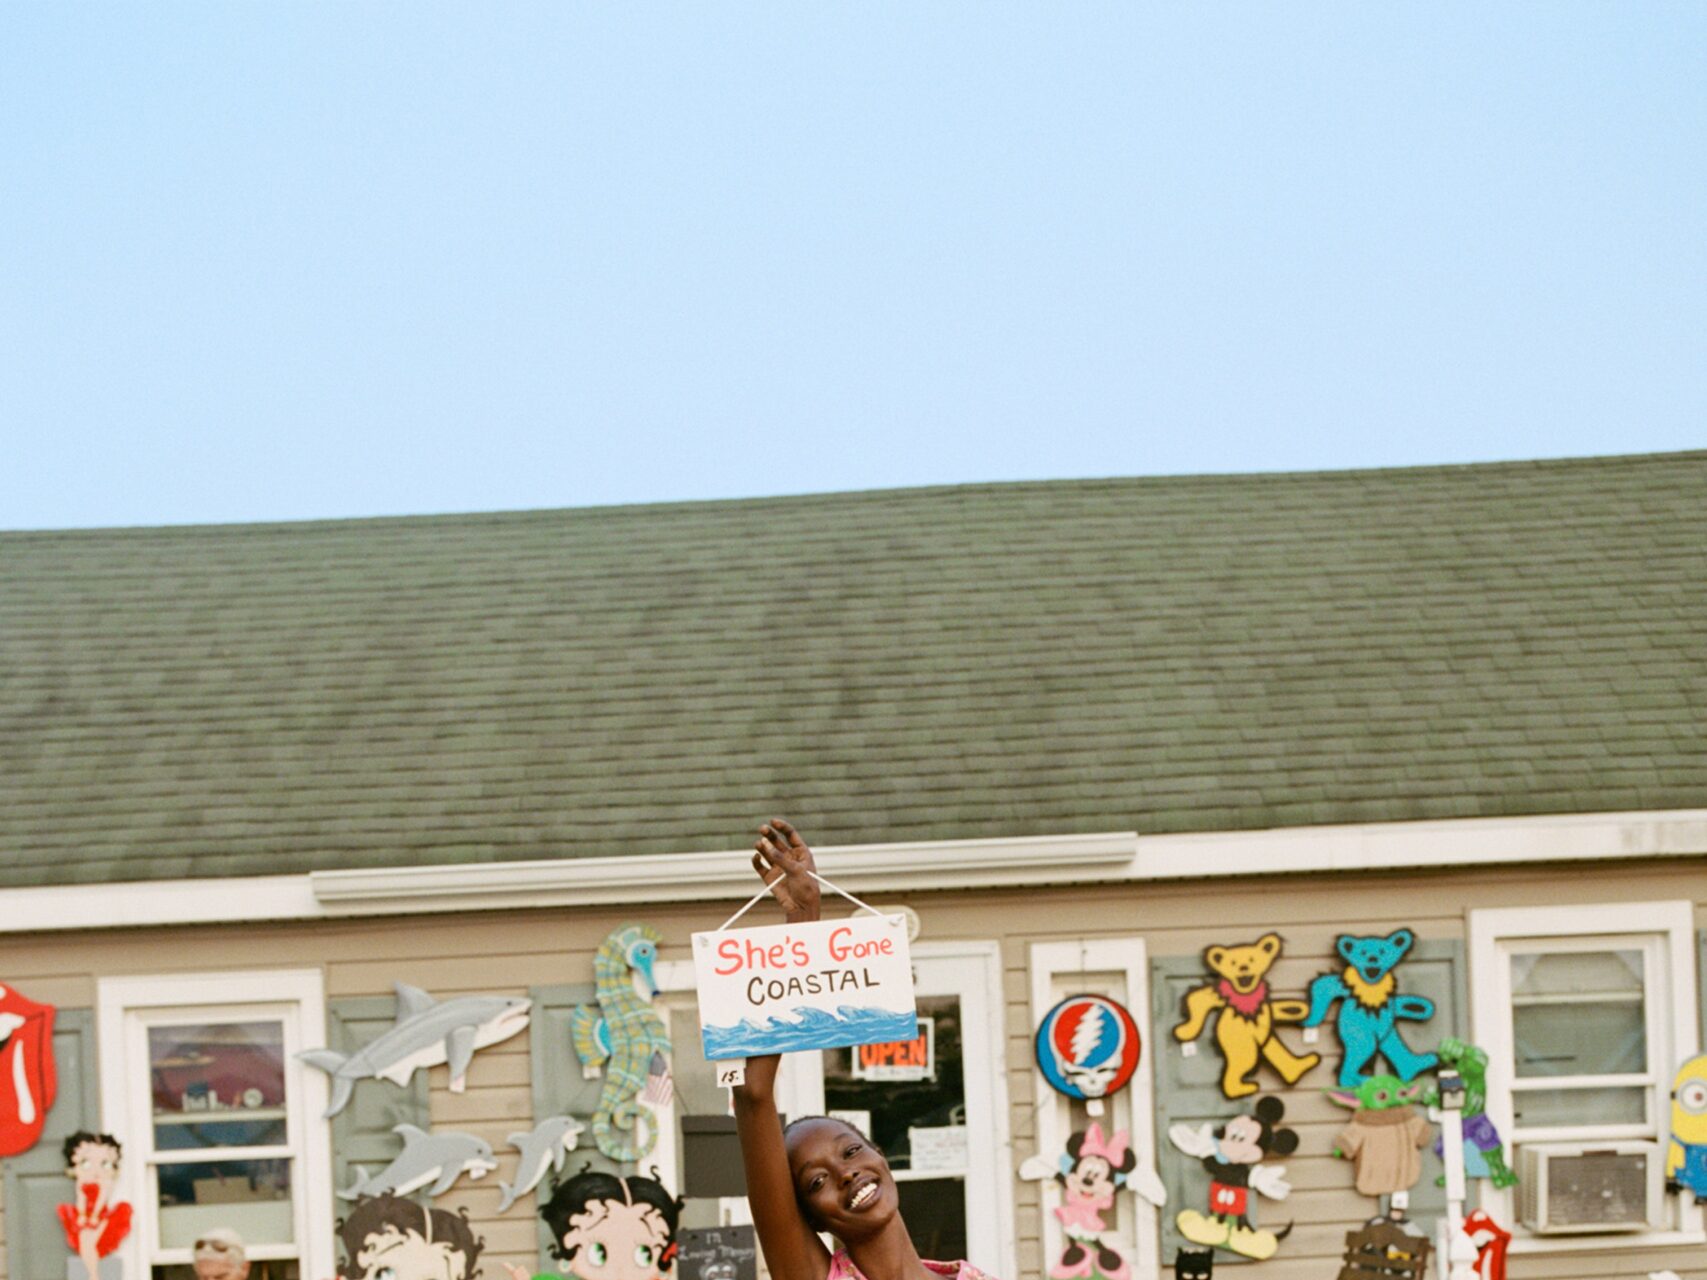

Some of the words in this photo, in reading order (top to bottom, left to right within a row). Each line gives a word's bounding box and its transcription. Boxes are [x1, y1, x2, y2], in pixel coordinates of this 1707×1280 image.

[715, 936, 809, 975] She's
[829, 928, 893, 962] Gone
[747, 968, 880, 1005] COASTAL
[860, 1034, 927, 1066] OPEN
